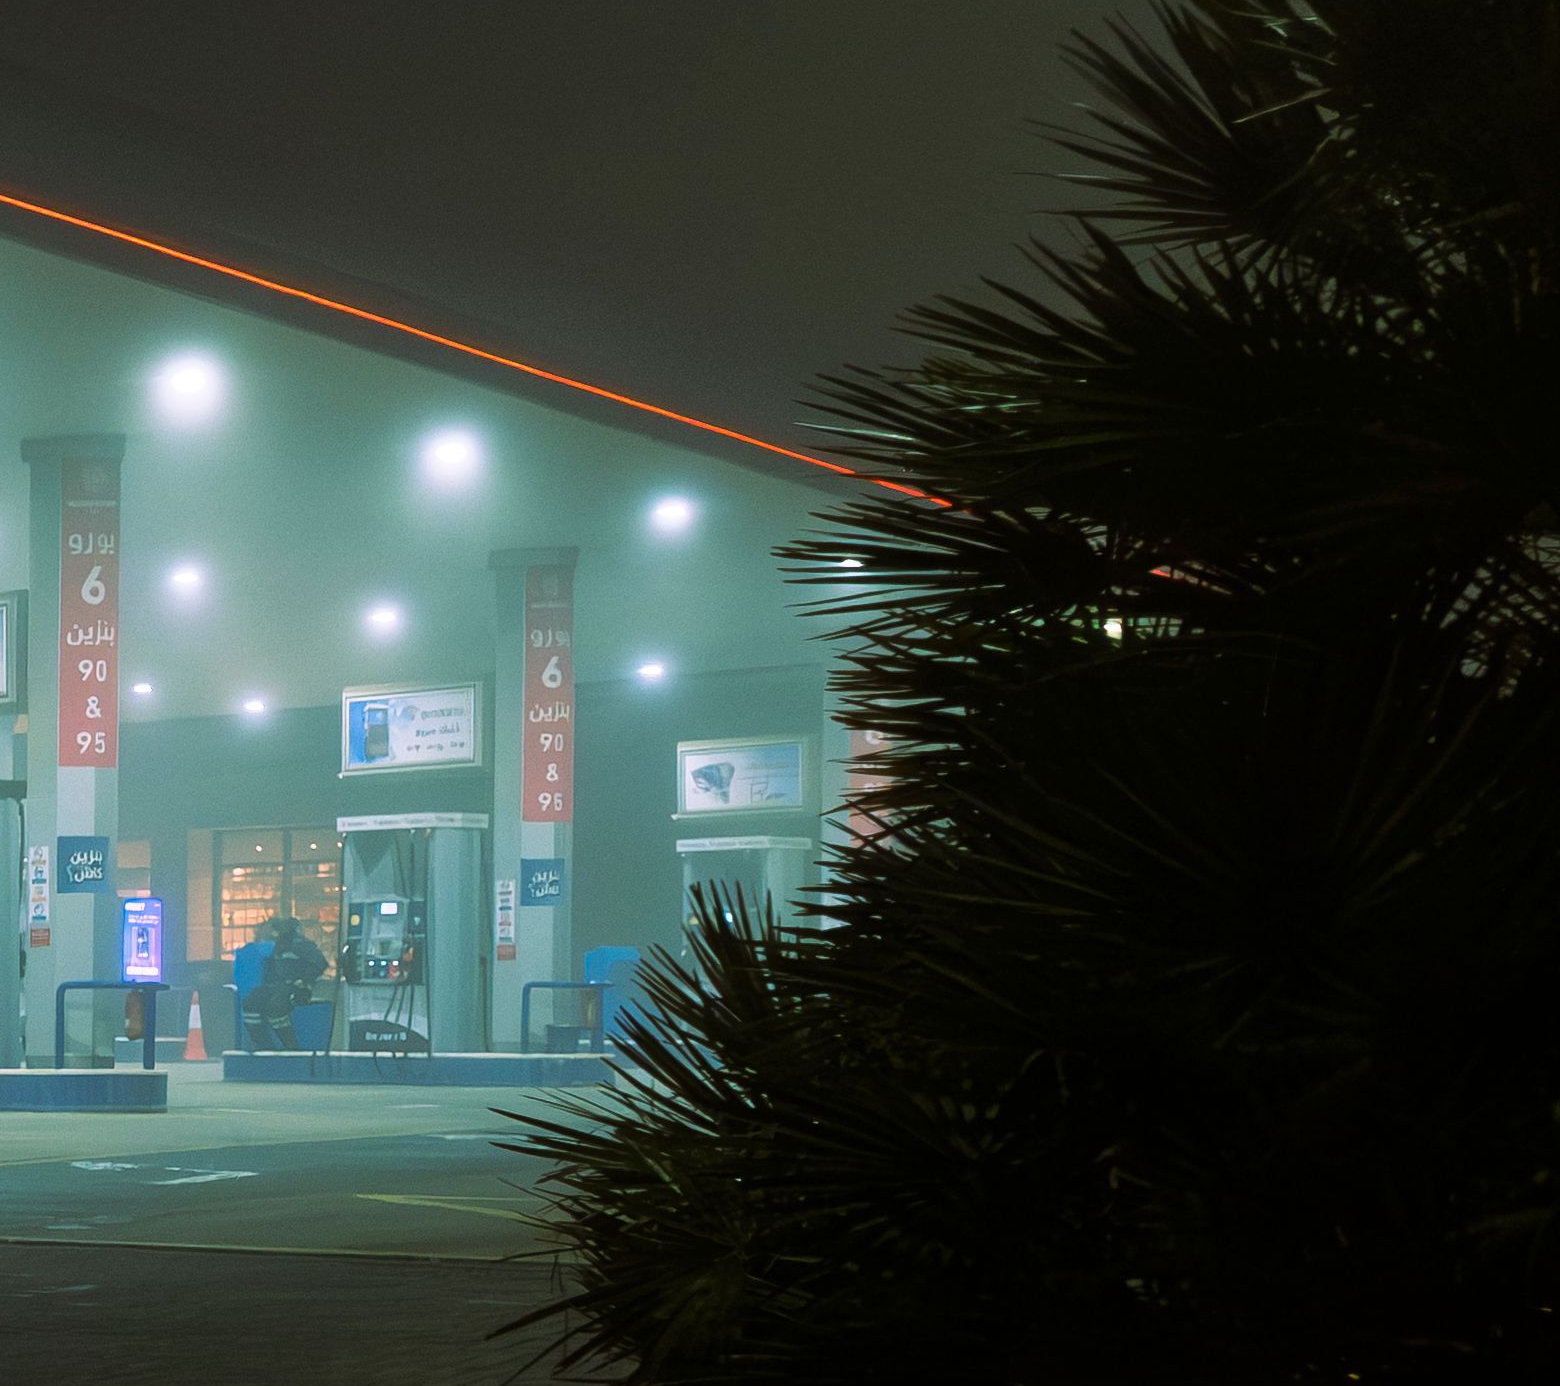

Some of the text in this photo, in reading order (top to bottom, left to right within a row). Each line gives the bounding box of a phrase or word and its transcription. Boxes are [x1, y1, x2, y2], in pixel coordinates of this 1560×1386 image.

[81, 565, 106, 605] 6
[78, 659, 107, 682] 90
[542, 655, 563, 689] 6
[85, 695, 102, 719] &
[76, 731, 106, 754] 95
[540, 733, 564, 752] 90
